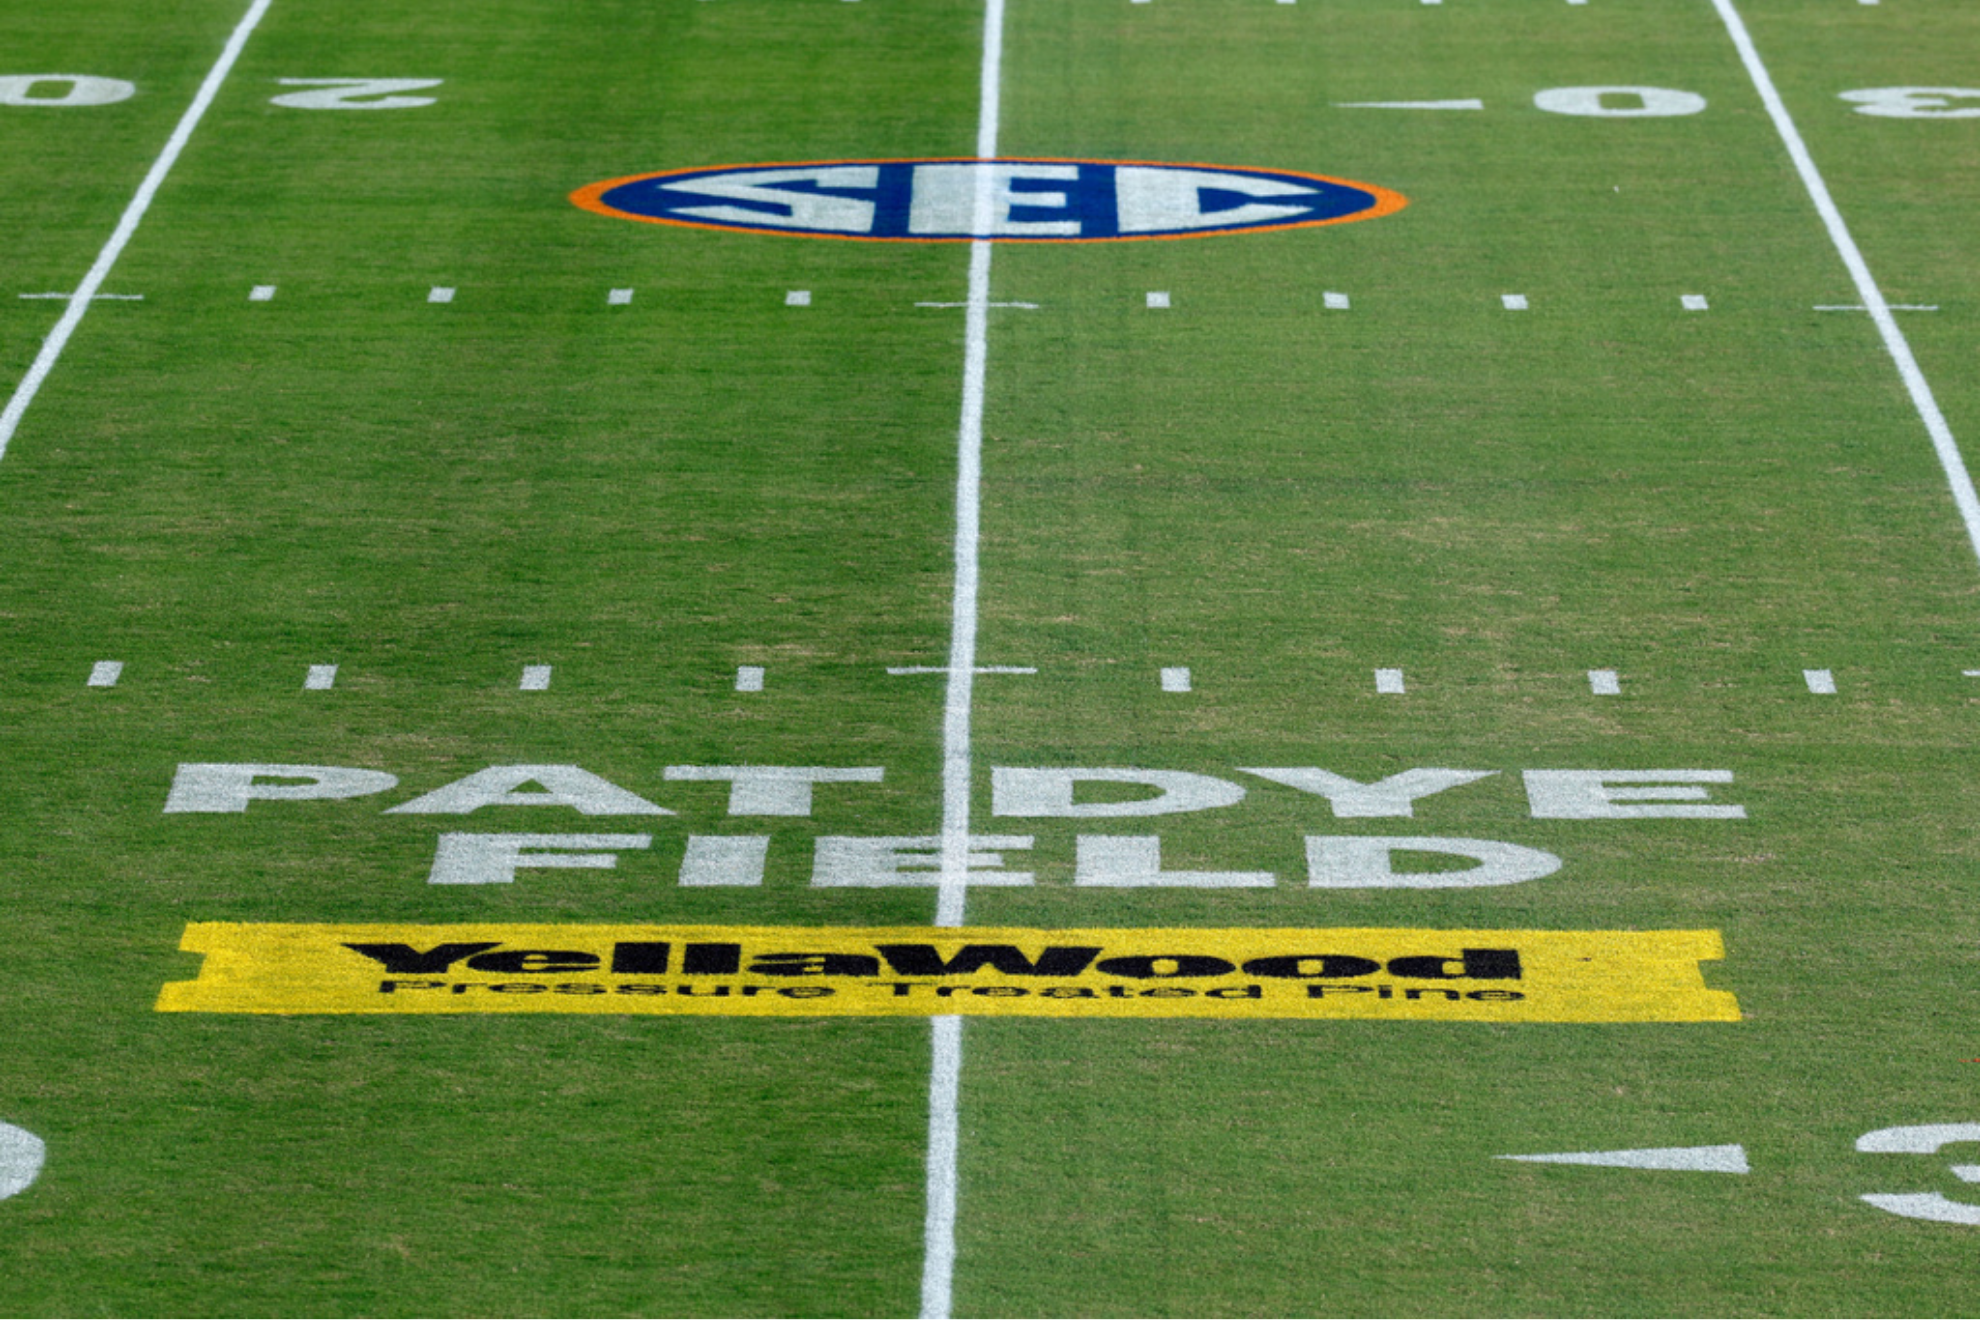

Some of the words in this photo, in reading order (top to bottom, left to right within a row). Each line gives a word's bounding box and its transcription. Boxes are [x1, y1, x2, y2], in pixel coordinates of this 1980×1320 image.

[656, 163, 1322, 236] SEC
[162, 761, 886, 817] PAT
[989, 763, 1750, 821] DYE
[427, 830, 1565, 891] FIELD
[341, 941, 1524, 981] YellaWood
[378, 979, 838, 1000] Pressure
[864, 981, 1264, 1000] Treated
[1305, 983, 1526, 1002] Pine
